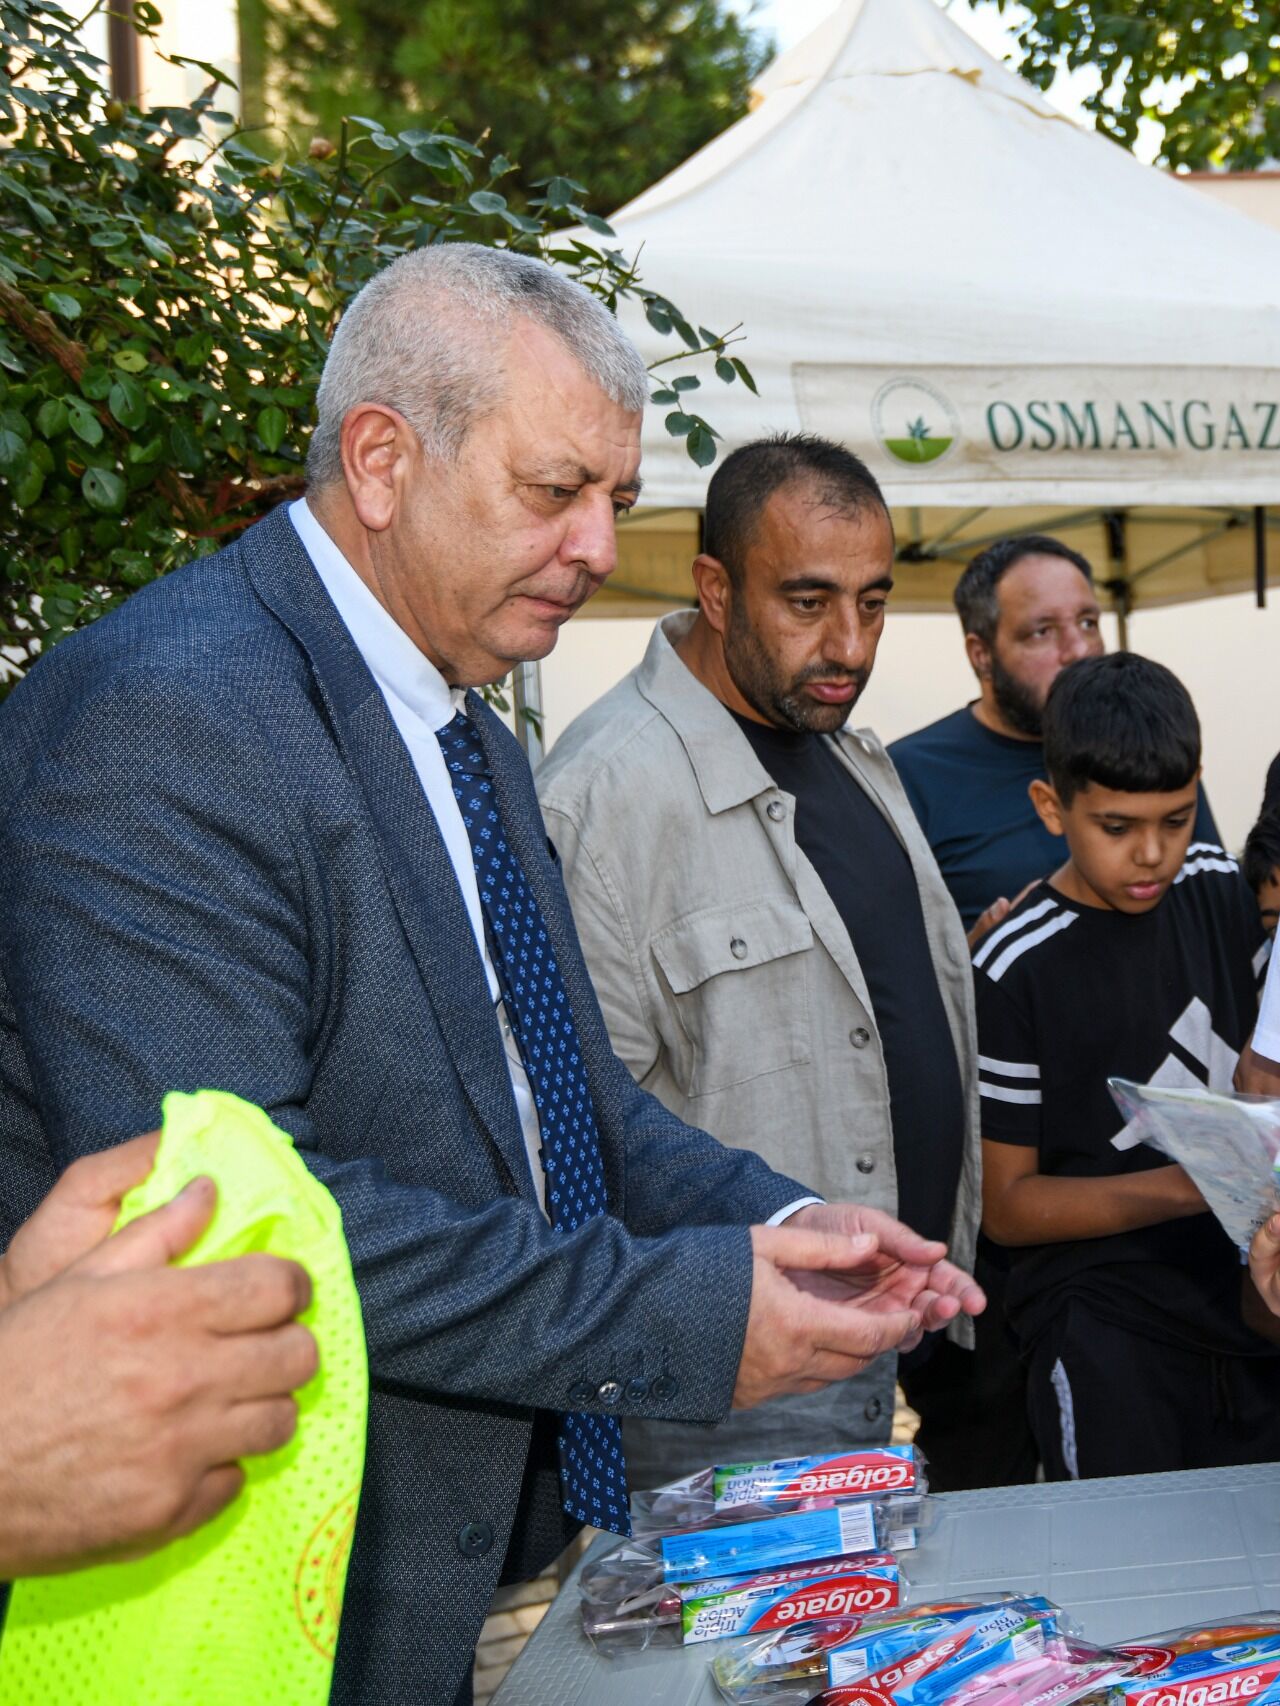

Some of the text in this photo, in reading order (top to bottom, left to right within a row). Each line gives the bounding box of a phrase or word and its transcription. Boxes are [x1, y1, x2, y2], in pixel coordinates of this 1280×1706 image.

[800, 1464, 909, 1493] Colgate
[753, 1556, 887, 1585] Colgate
[776, 1586, 892, 1620] Colgate
[694, 1619, 738, 1637] Triple
[868, 1639, 957, 1689] lgate
[1135, 1674, 1261, 1706] Colgate
